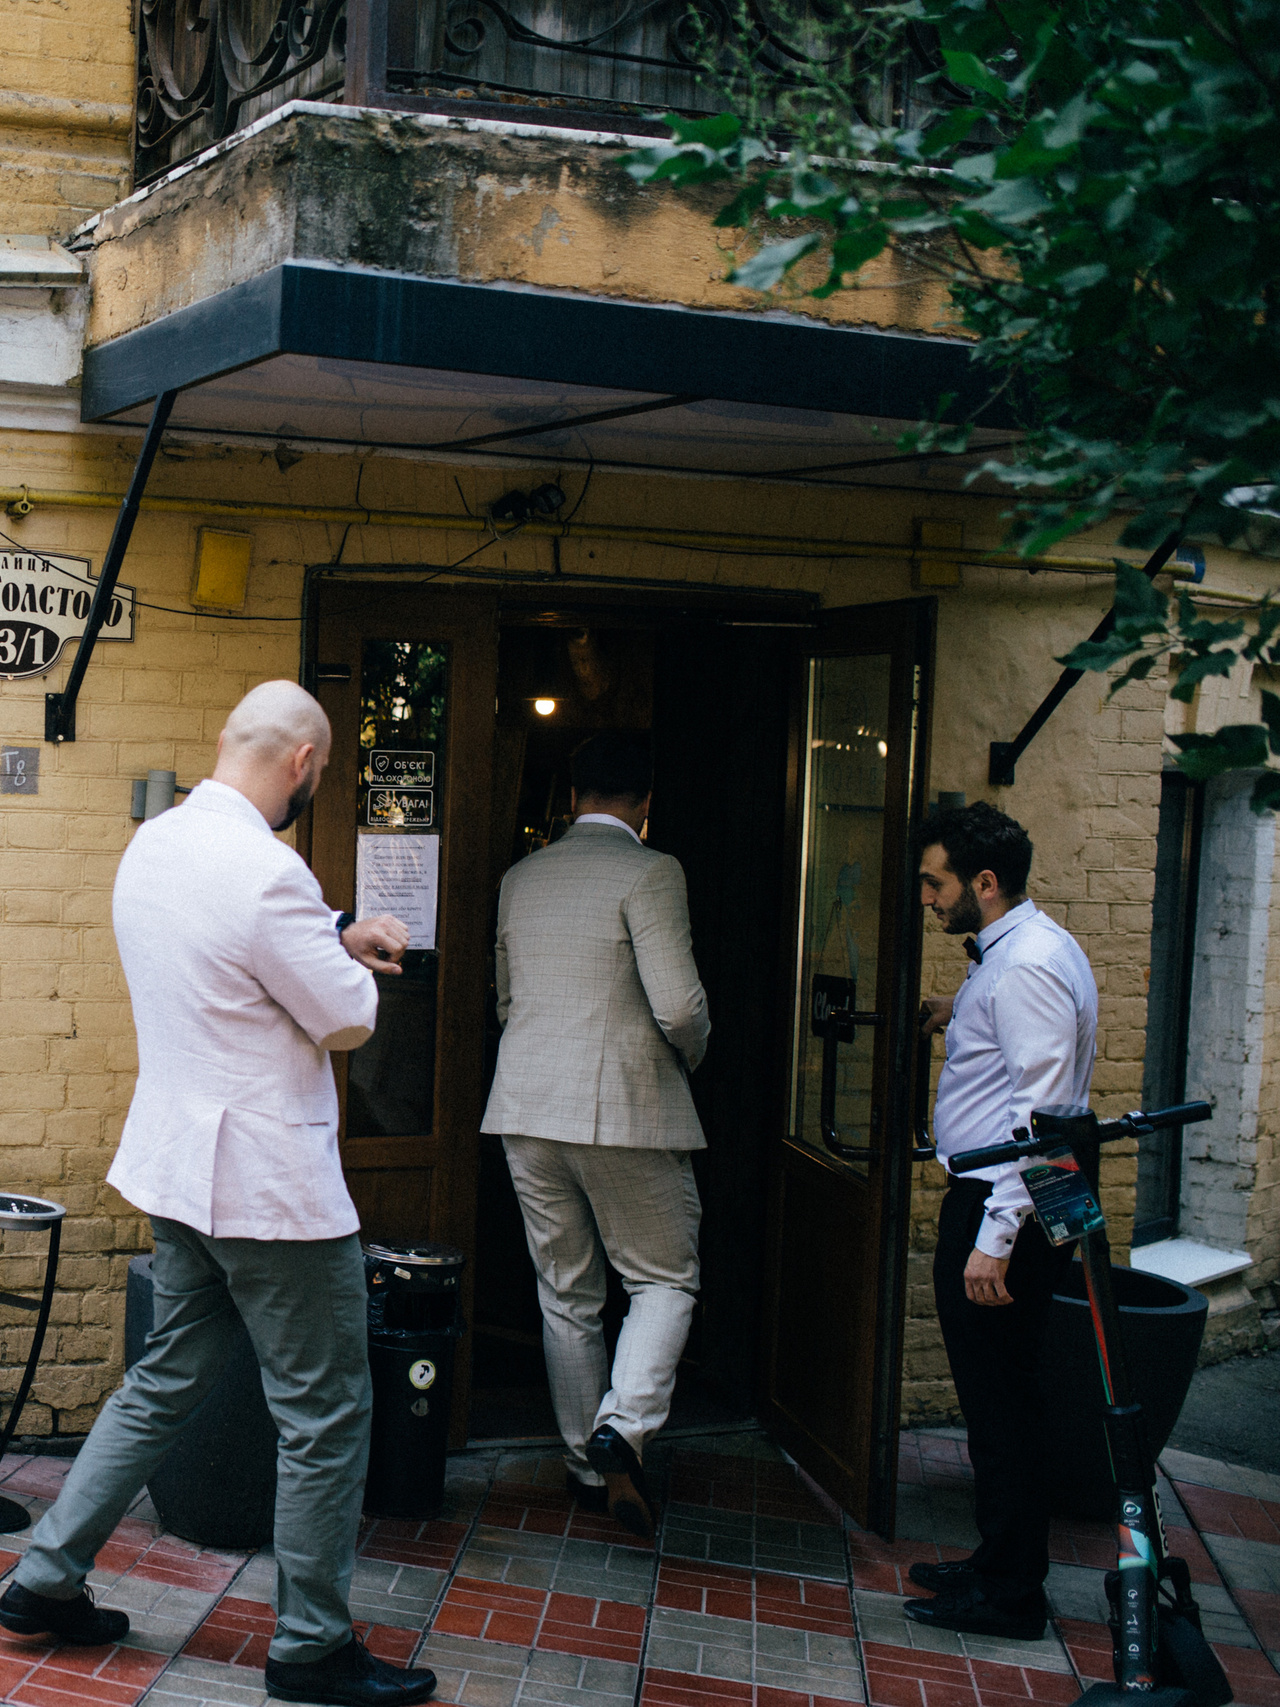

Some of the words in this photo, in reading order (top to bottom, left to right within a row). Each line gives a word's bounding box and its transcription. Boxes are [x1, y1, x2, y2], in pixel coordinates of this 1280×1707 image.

[394, 760, 426, 770] ОБ'ЄКТ
[371, 774, 384, 782] ПІД
[385, 774, 431, 783] ОХОРОНОЮ
